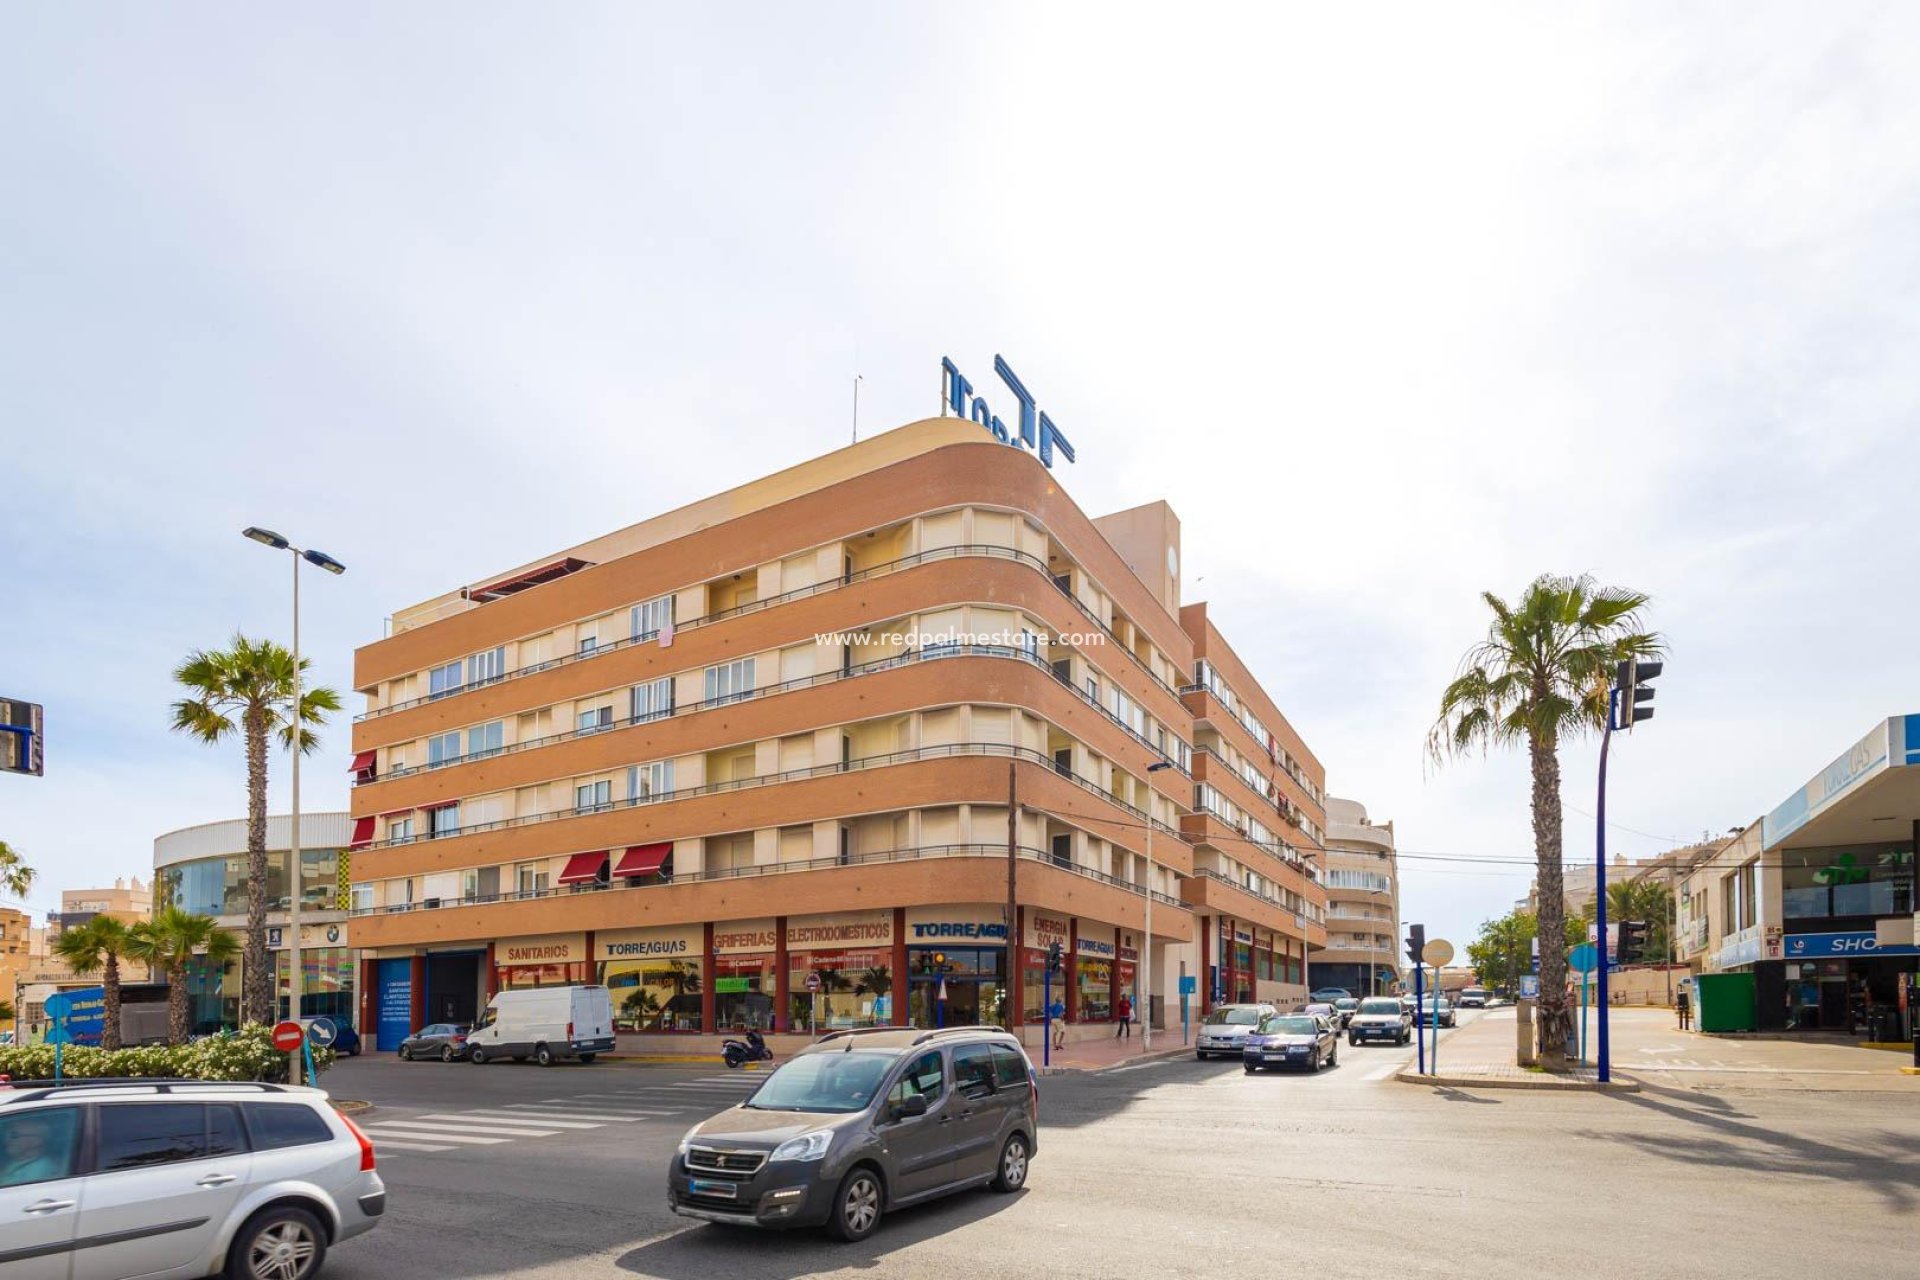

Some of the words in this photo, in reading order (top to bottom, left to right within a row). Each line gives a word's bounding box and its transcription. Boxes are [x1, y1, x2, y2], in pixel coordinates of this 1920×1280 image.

[606, 940, 687, 955] TORREAGUAS
[1830, 937, 1883, 951] SHO
[508, 944, 569, 960] SANITARIOS
